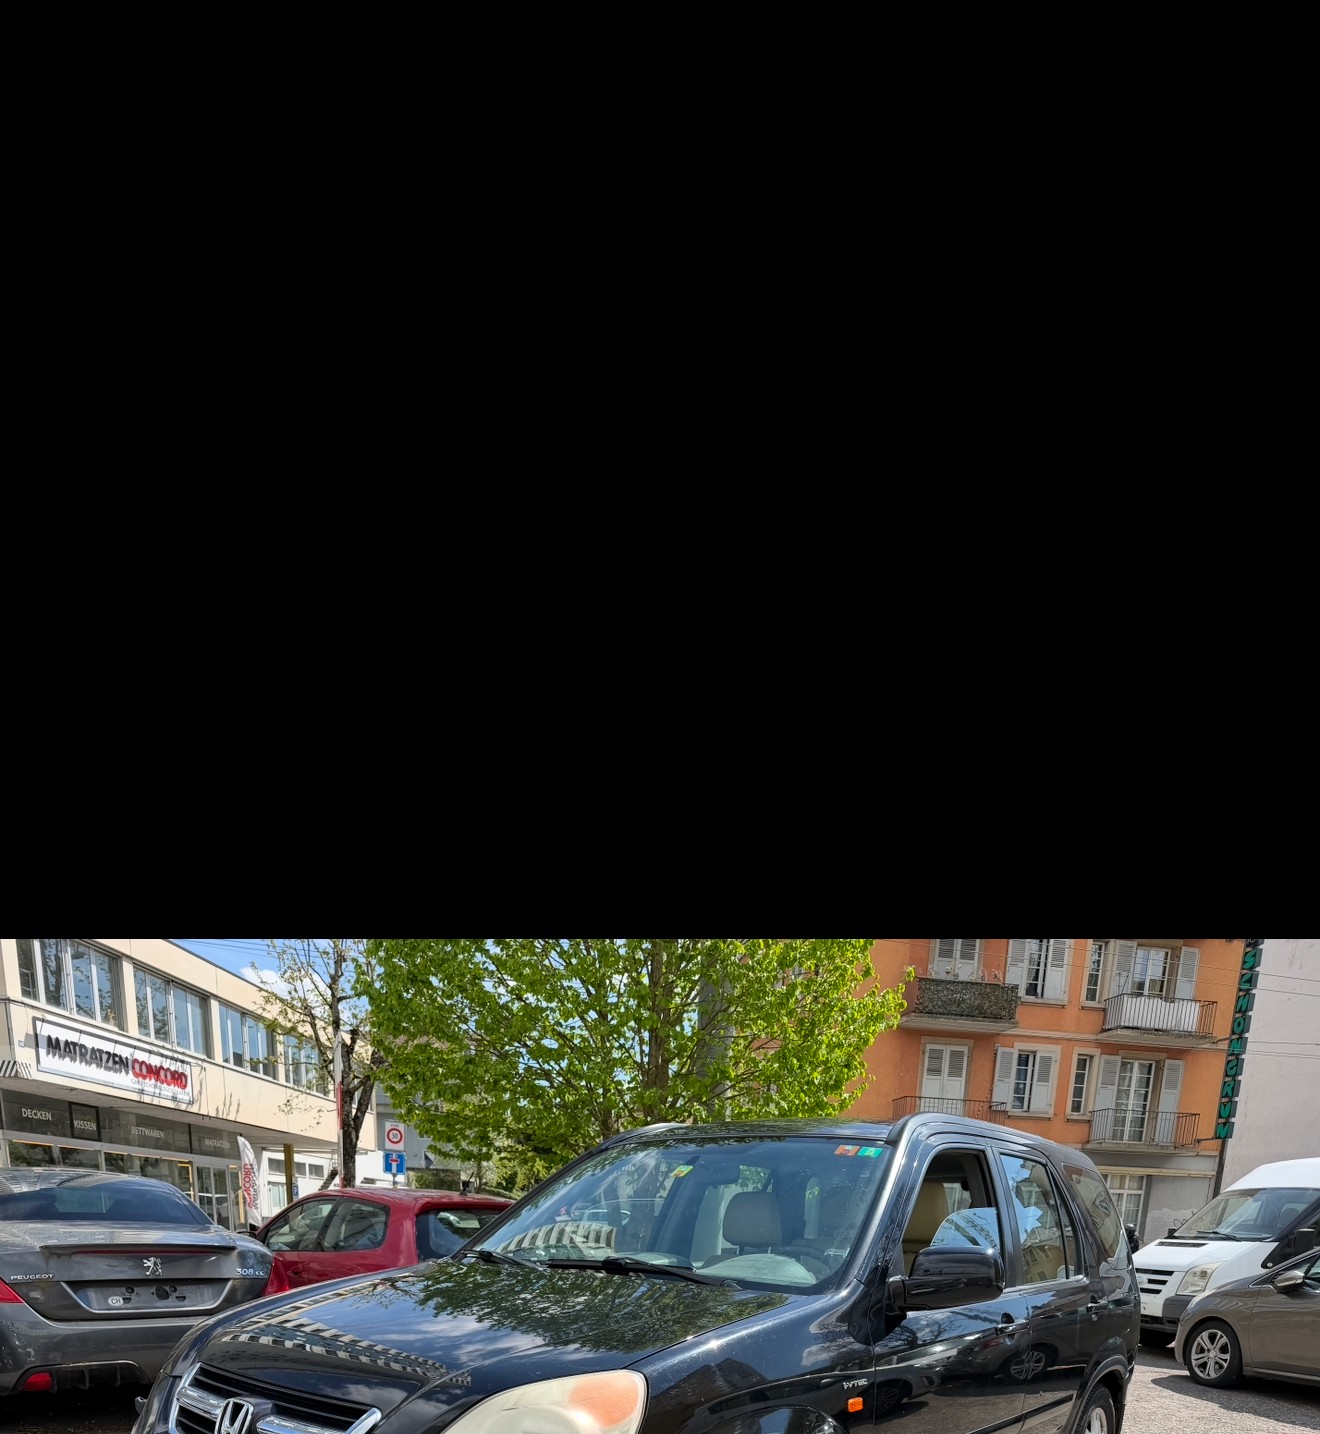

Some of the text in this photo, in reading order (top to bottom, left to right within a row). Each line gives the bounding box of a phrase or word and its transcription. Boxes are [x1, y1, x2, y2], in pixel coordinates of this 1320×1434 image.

[46, 1034, 188, 1090] MATRATZEN CONCORD
[21, 1108, 52, 1121] DECKEN
[73, 1119, 97, 1131] KISSEN
[131, 1126, 165, 1138] BETTWAREN
[391, 1132, 399, 1140] 30
[236, 1268, 254, 1276] 308
[110, 1297, 121, 1305] CH
